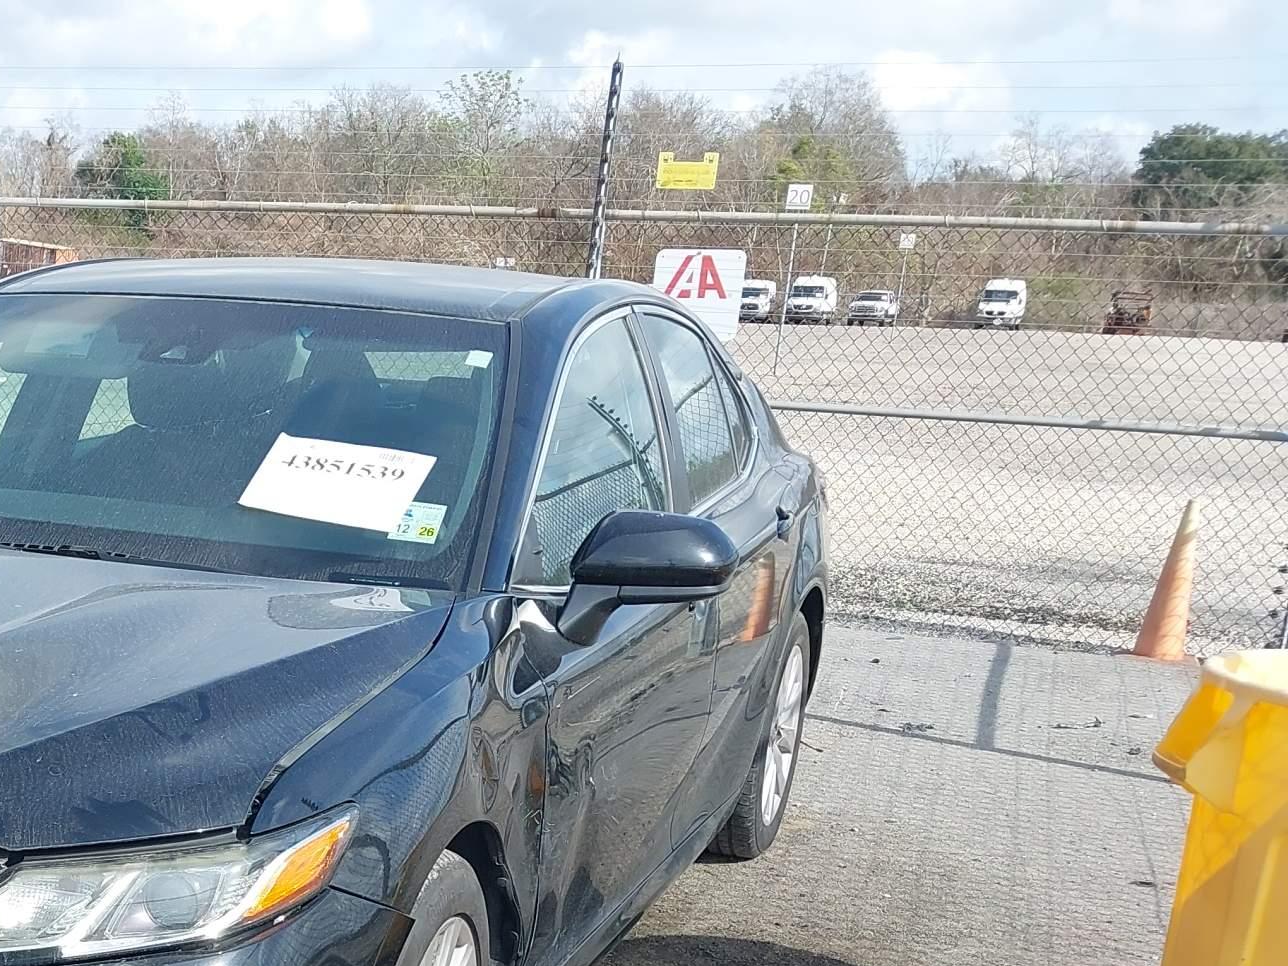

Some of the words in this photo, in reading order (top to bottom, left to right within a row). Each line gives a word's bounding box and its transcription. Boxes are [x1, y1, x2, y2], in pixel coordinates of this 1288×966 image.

[789, 189, 810, 204] 20
[282, 454, 405, 481] 43851539
[397, 523, 410, 533] 12
[418, 526, 435, 537] 26
